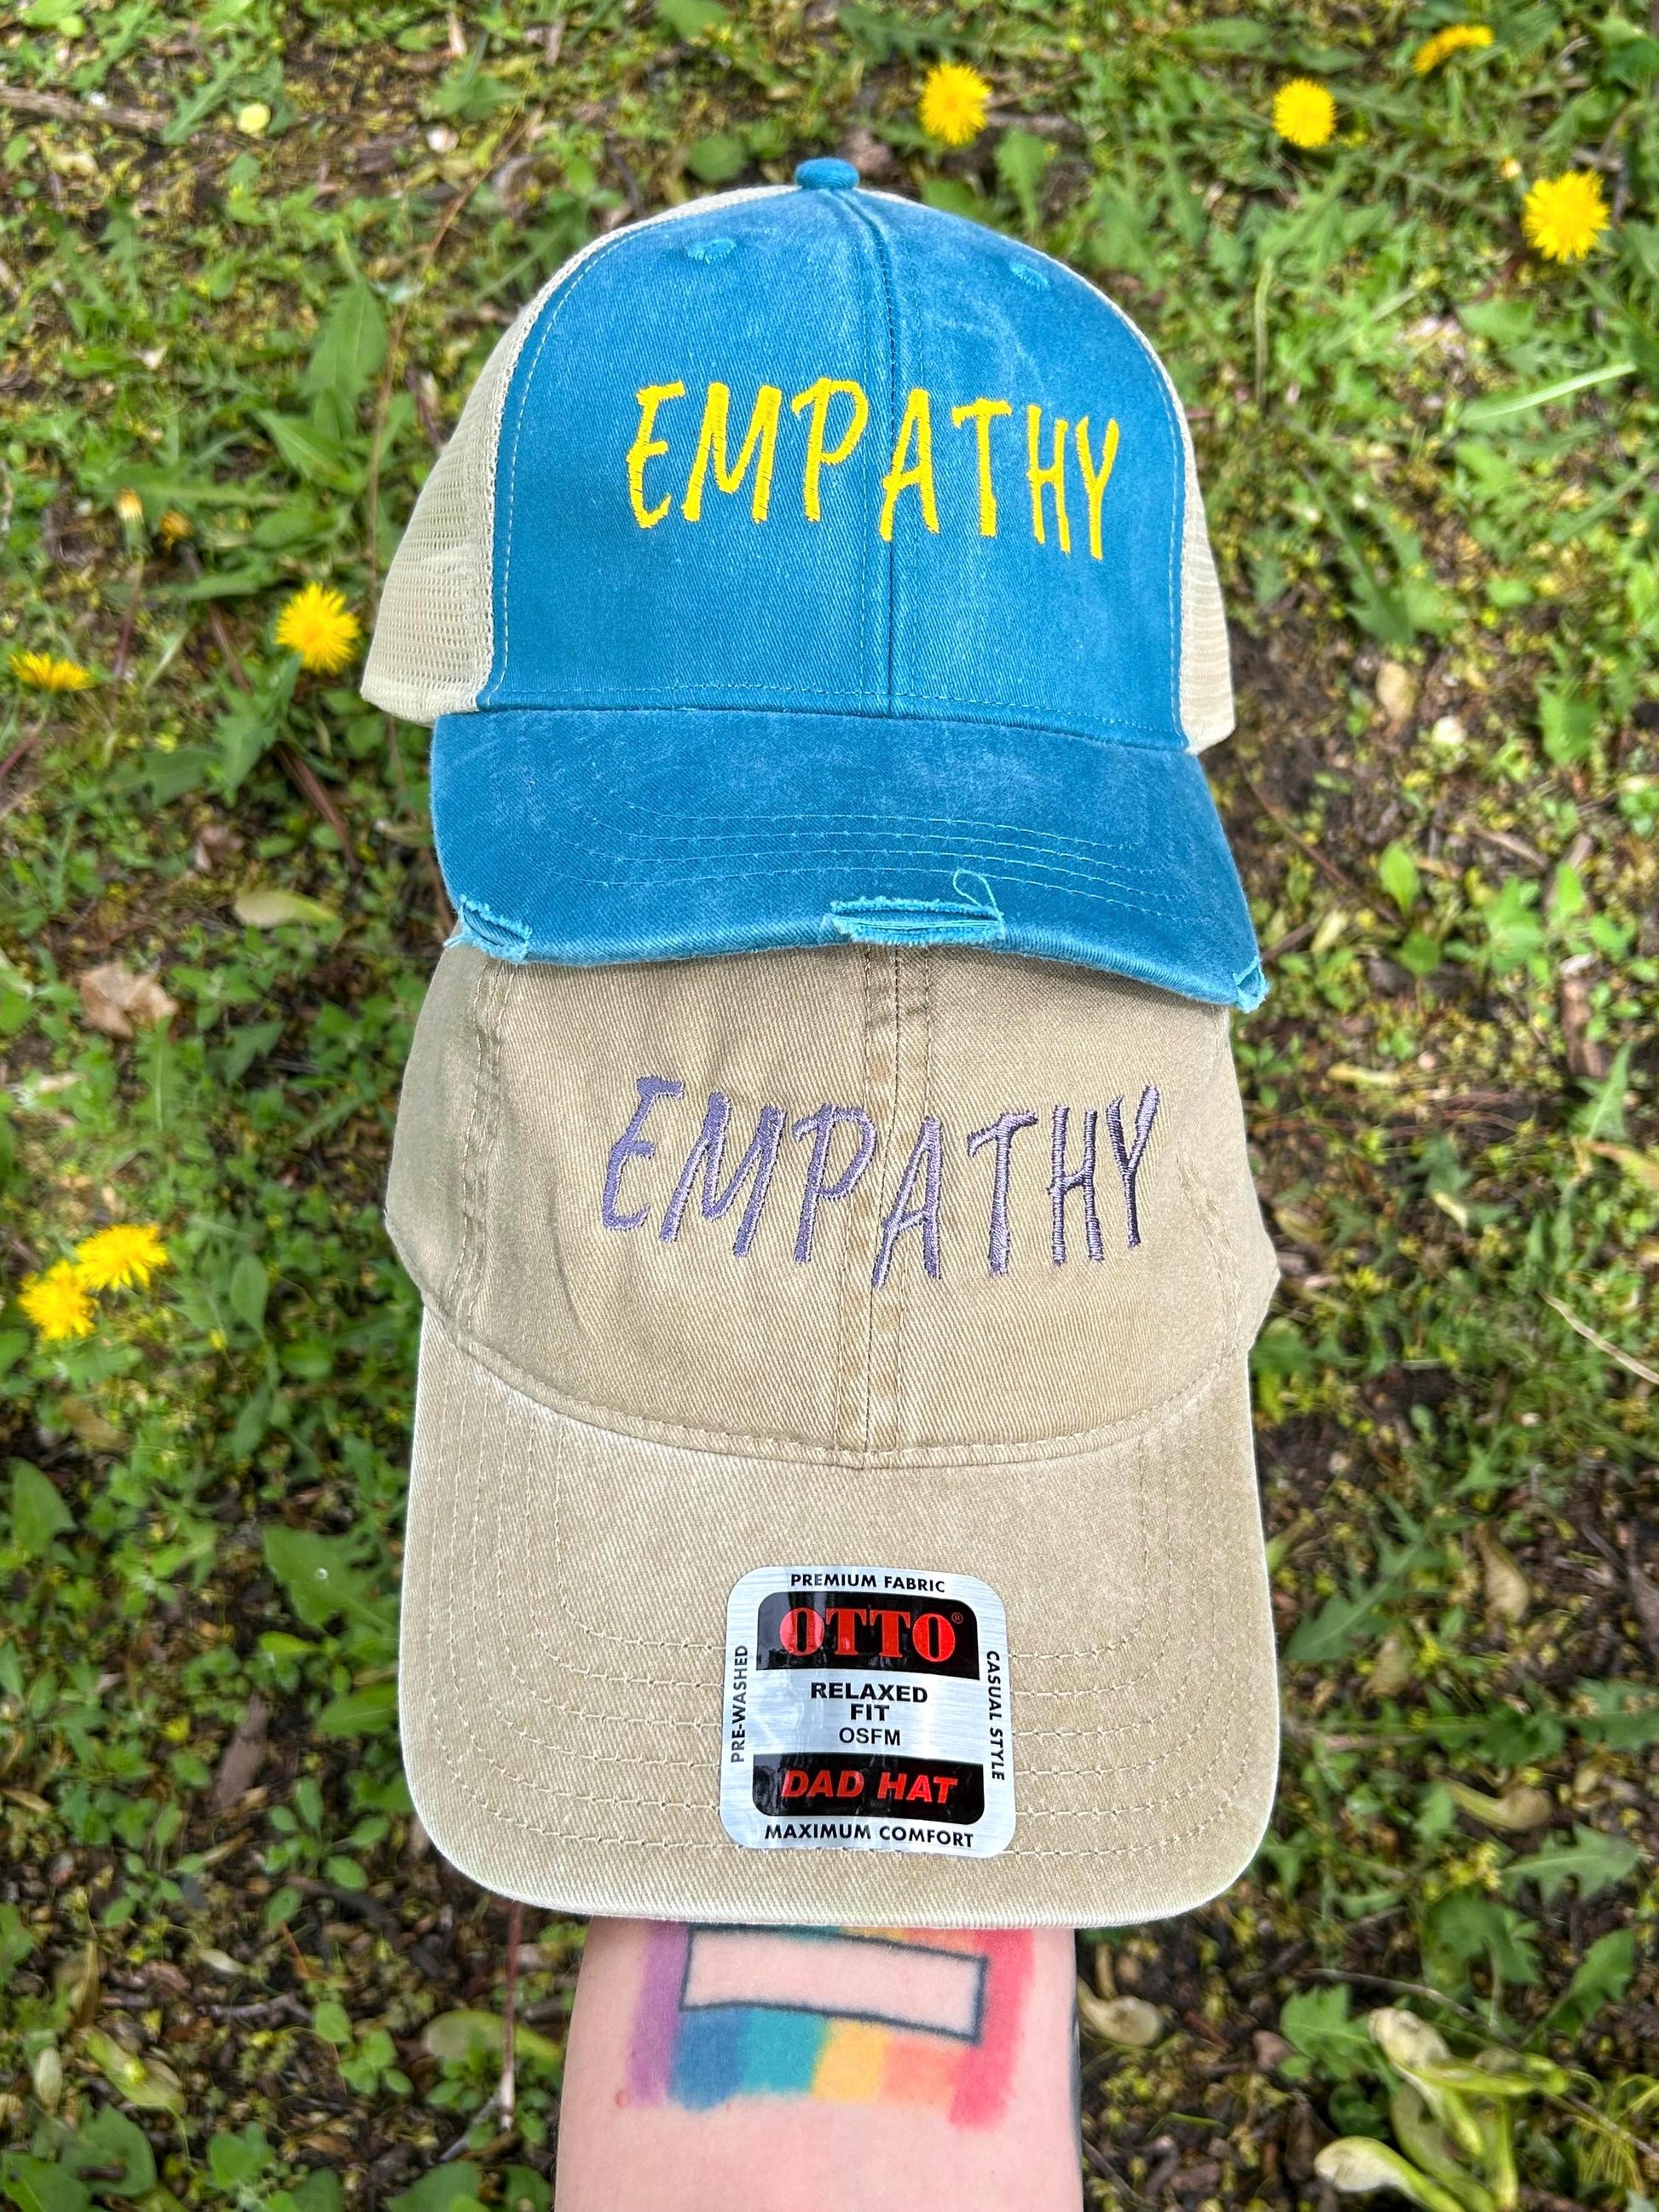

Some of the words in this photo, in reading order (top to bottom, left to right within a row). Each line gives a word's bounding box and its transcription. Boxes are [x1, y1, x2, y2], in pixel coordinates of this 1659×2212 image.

[627, 378, 1119, 560] EMPATHY
[601, 1075, 1161, 1291] EMPATHY
[790, 1574, 877, 1588] PREMIUM
[883, 1576, 945, 1593] FABRIC
[811, 1682, 928, 1703] RELAXED
[986, 1650, 1003, 1721] CASUAL
[731, 1644, 749, 1763] PRE-WASHED
[850, 1703, 890, 1722] FIT
[839, 1727, 901, 1746] OSFM
[990, 1727, 1005, 1781] STYLE
[781, 1770, 864, 1799] DAD
[877, 1771, 958, 1804] HAT
[765, 1824, 871, 1839] MAXIMUM
[879, 1826, 974, 1847] COMFORT
